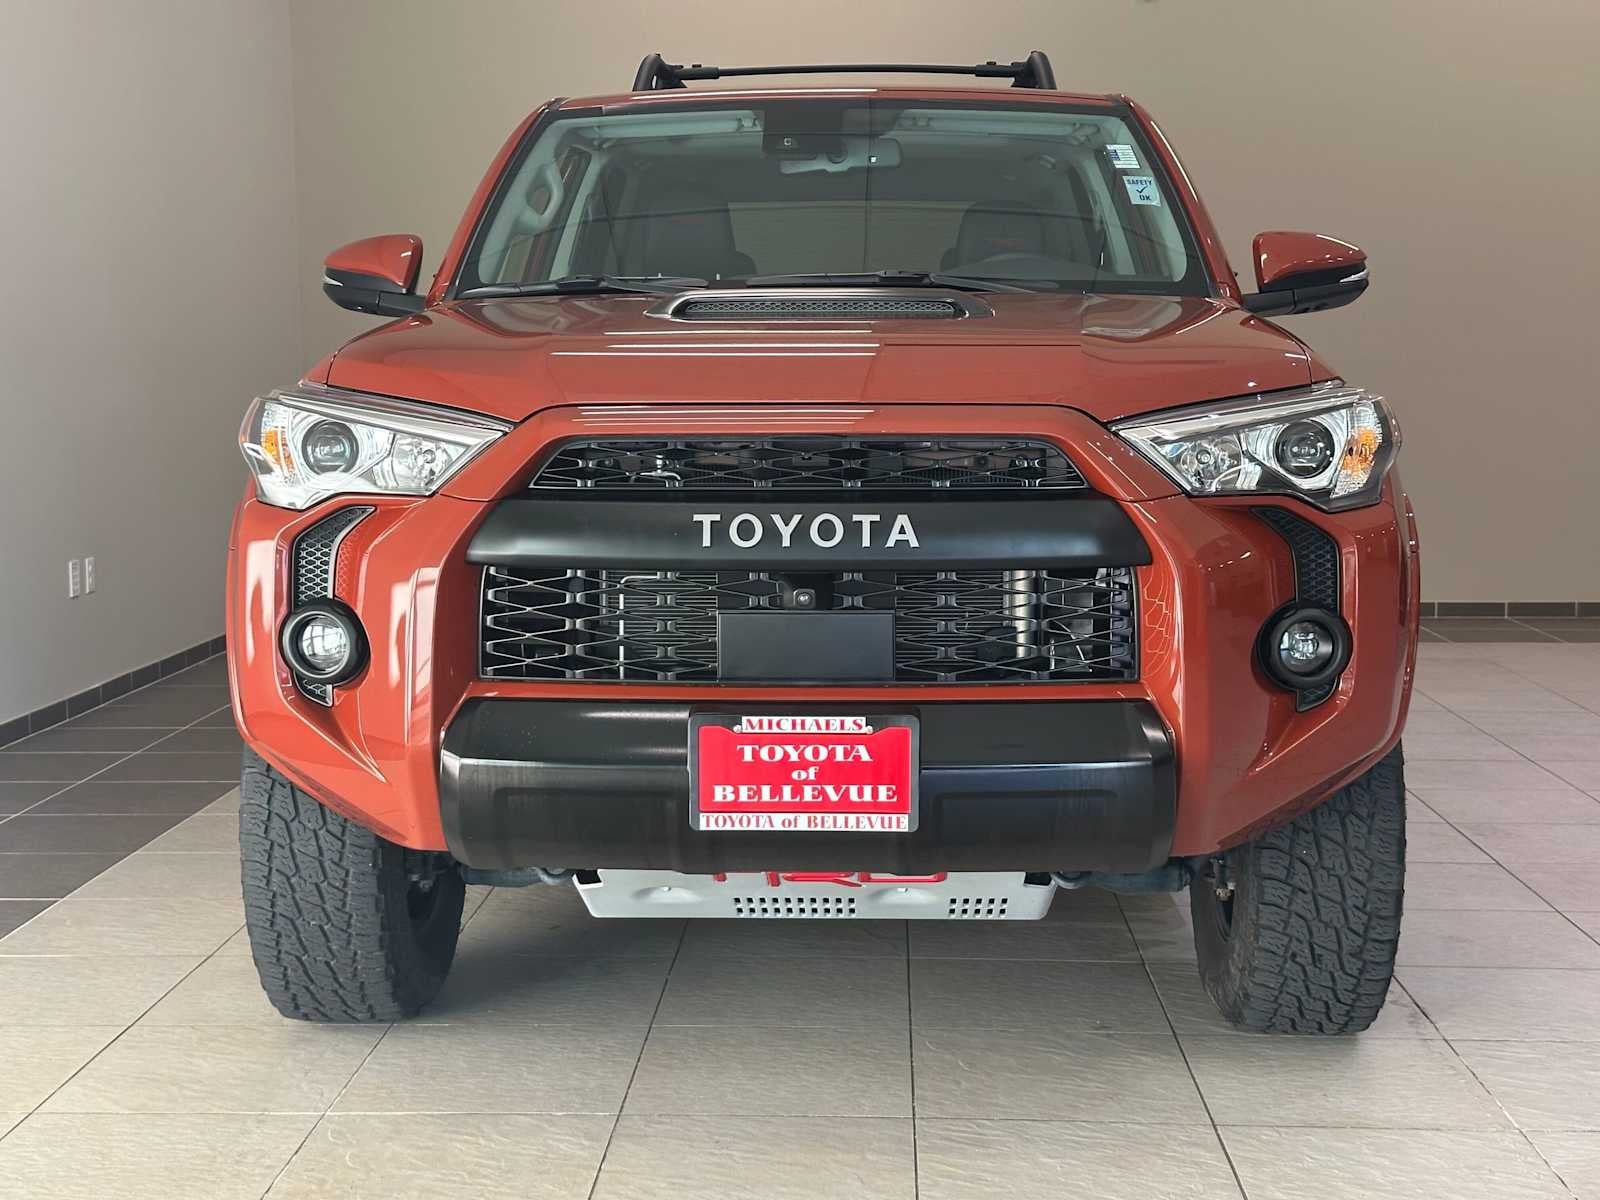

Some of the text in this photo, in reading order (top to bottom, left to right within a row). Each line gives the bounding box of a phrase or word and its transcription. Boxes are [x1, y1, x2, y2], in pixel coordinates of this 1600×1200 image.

[692, 513, 920, 548] TOYOTA
[745, 718, 864, 731] MICHAELS
[736, 744, 873, 762] TOYOTA
[791, 766, 820, 781] of
[712, 785, 898, 802] BELLEVUE
[702, 814, 907, 830] TOYOTA of BELLEVUE
